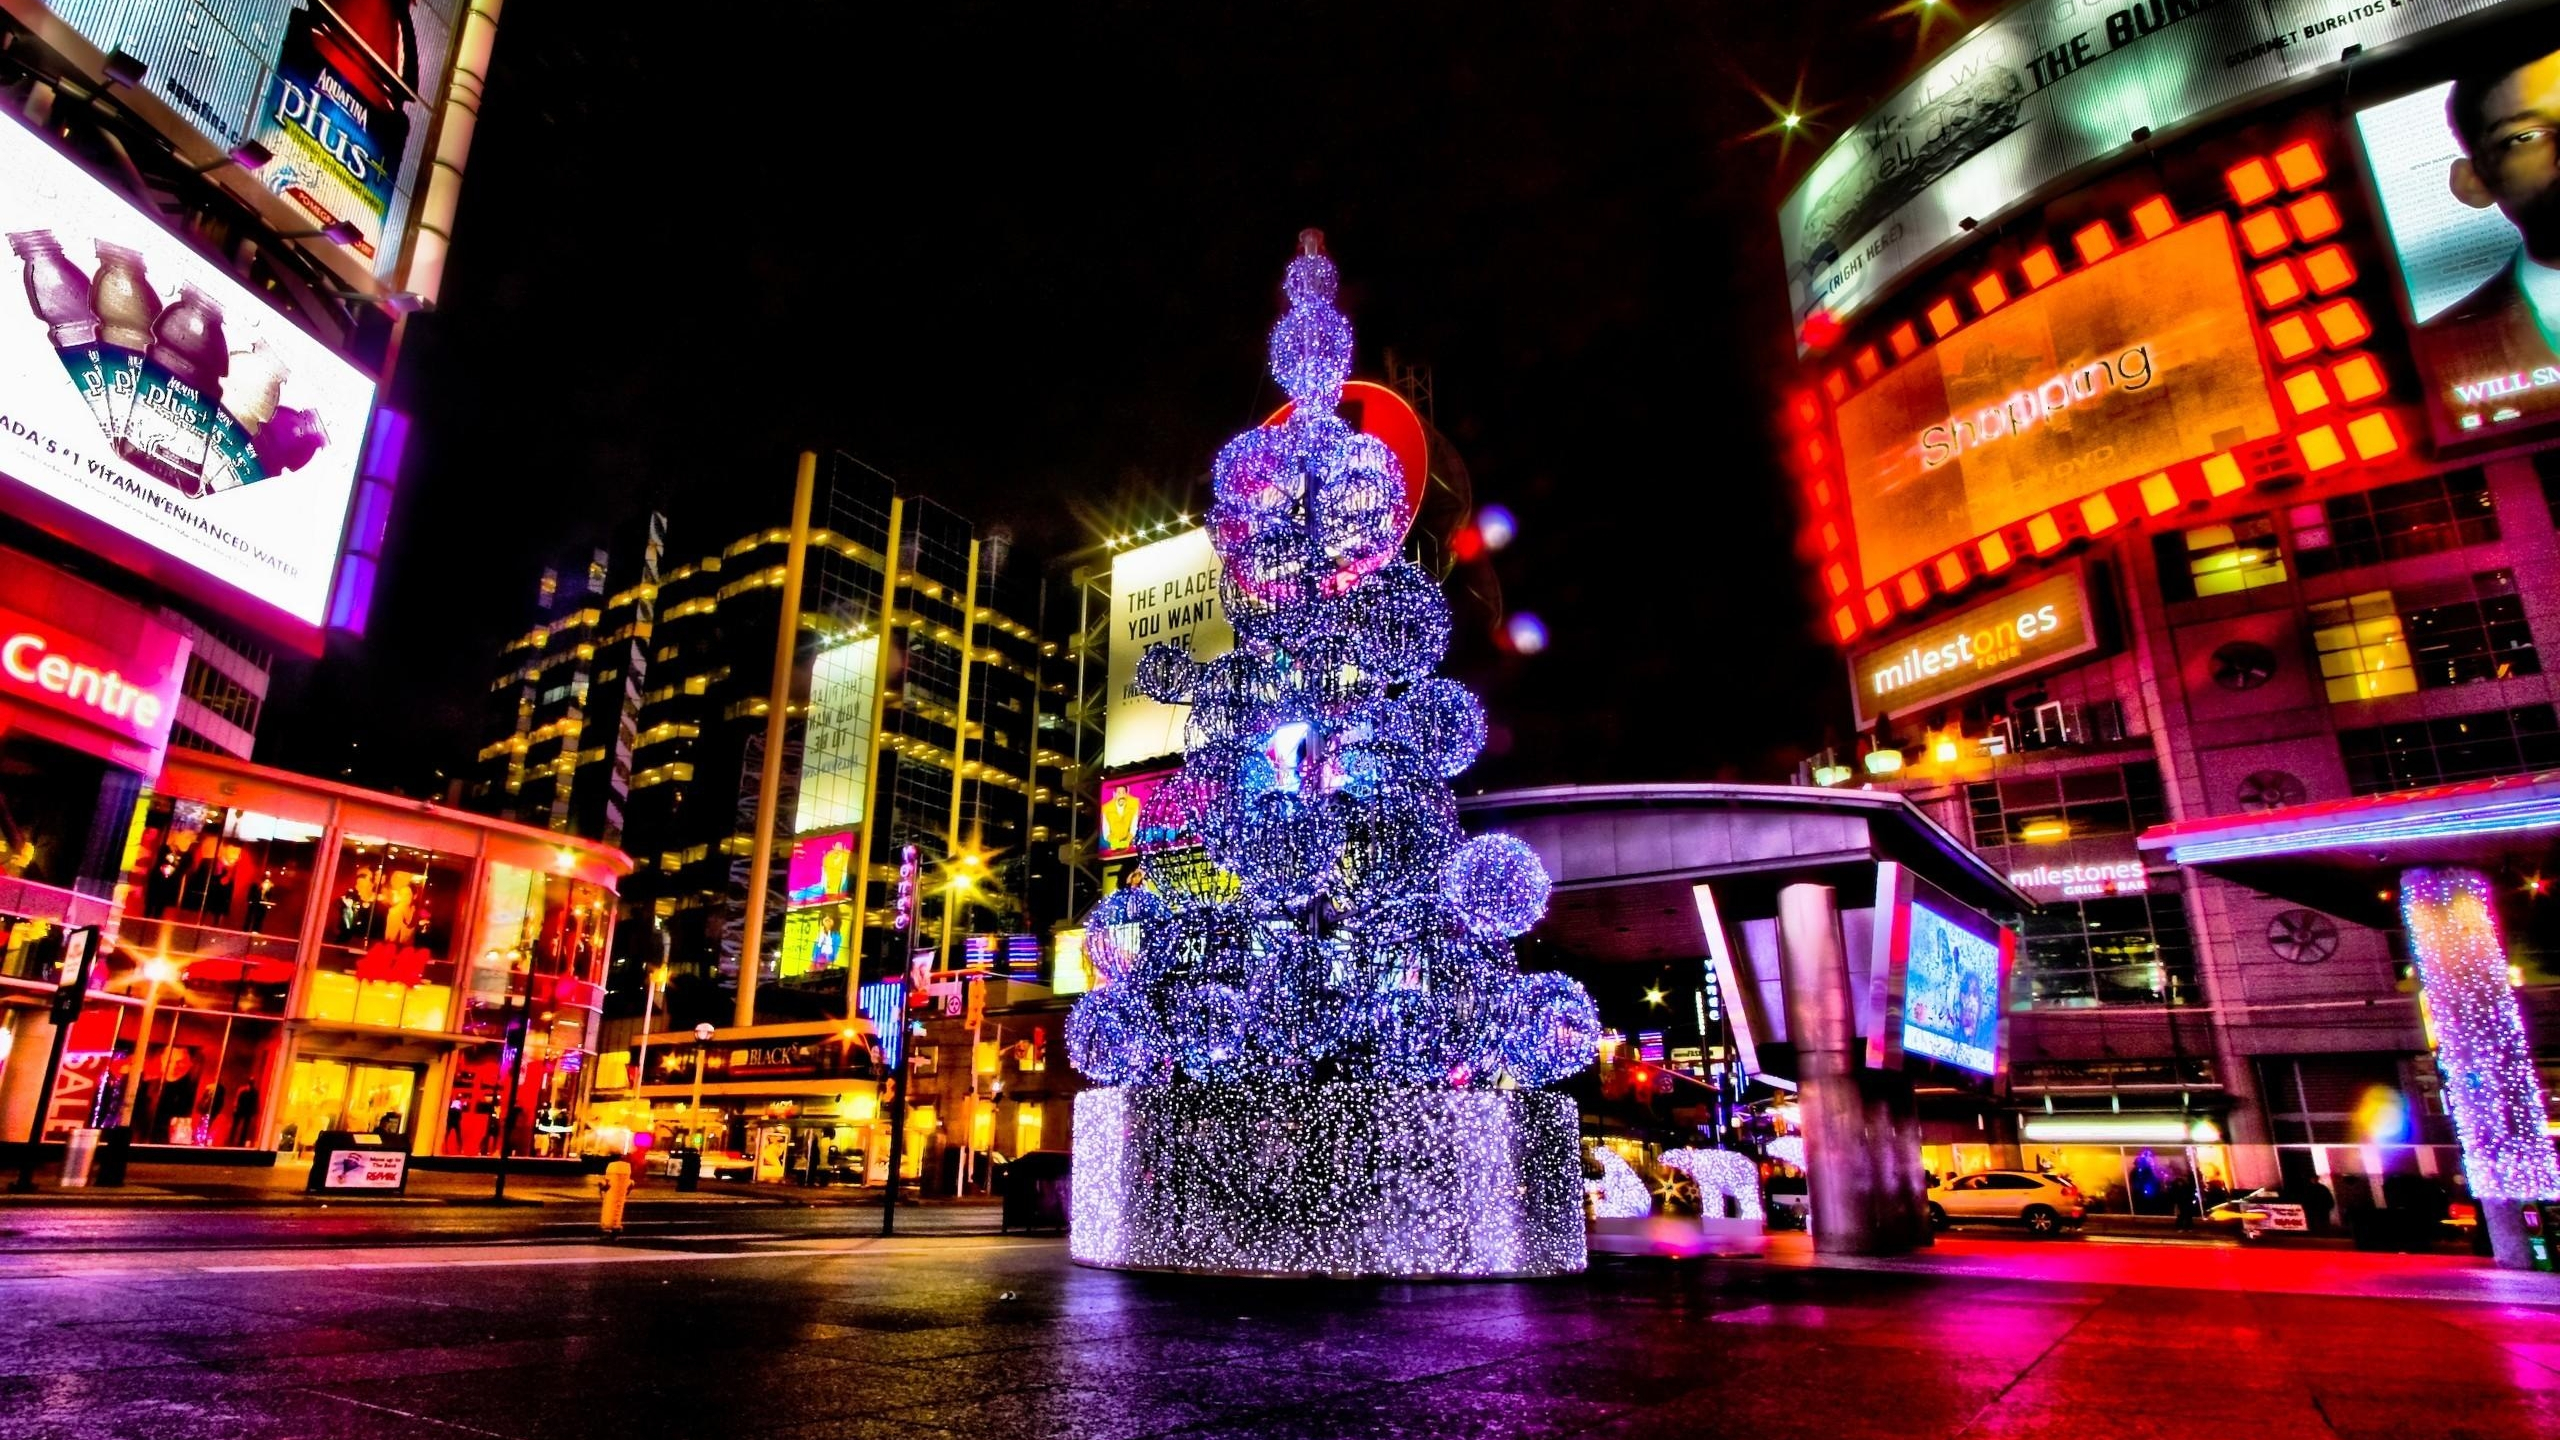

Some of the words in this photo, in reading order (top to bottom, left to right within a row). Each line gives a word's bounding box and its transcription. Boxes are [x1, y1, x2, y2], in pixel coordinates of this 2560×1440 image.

[2026, 32, 2096, 90] THE
[2226, 31, 2297, 68] GOURMET
[2304, 1, 2386, 39] BURRITOS
[315, 68, 367, 133] AQUAFINA
[1921, 345, 2153, 468] Shopping
[2454, 372, 2531, 402] WILL
[253, 546, 299, 578] WATER
[1128, 586, 1156, 613] THE
[1164, 569, 1217, 604] PLACE
[1129, 612, 1160, 641] YOU
[1168, 598, 1214, 629] WANT
[1873, 605, 2058, 695] milestones
[2, 633, 160, 728] Centre
[2009, 862, 2144, 887] milestones
[2063, 884, 2104, 896] GRILL
[2117, 880, 2147, 892] BAR
[48, 1051, 102, 1134] SALE
